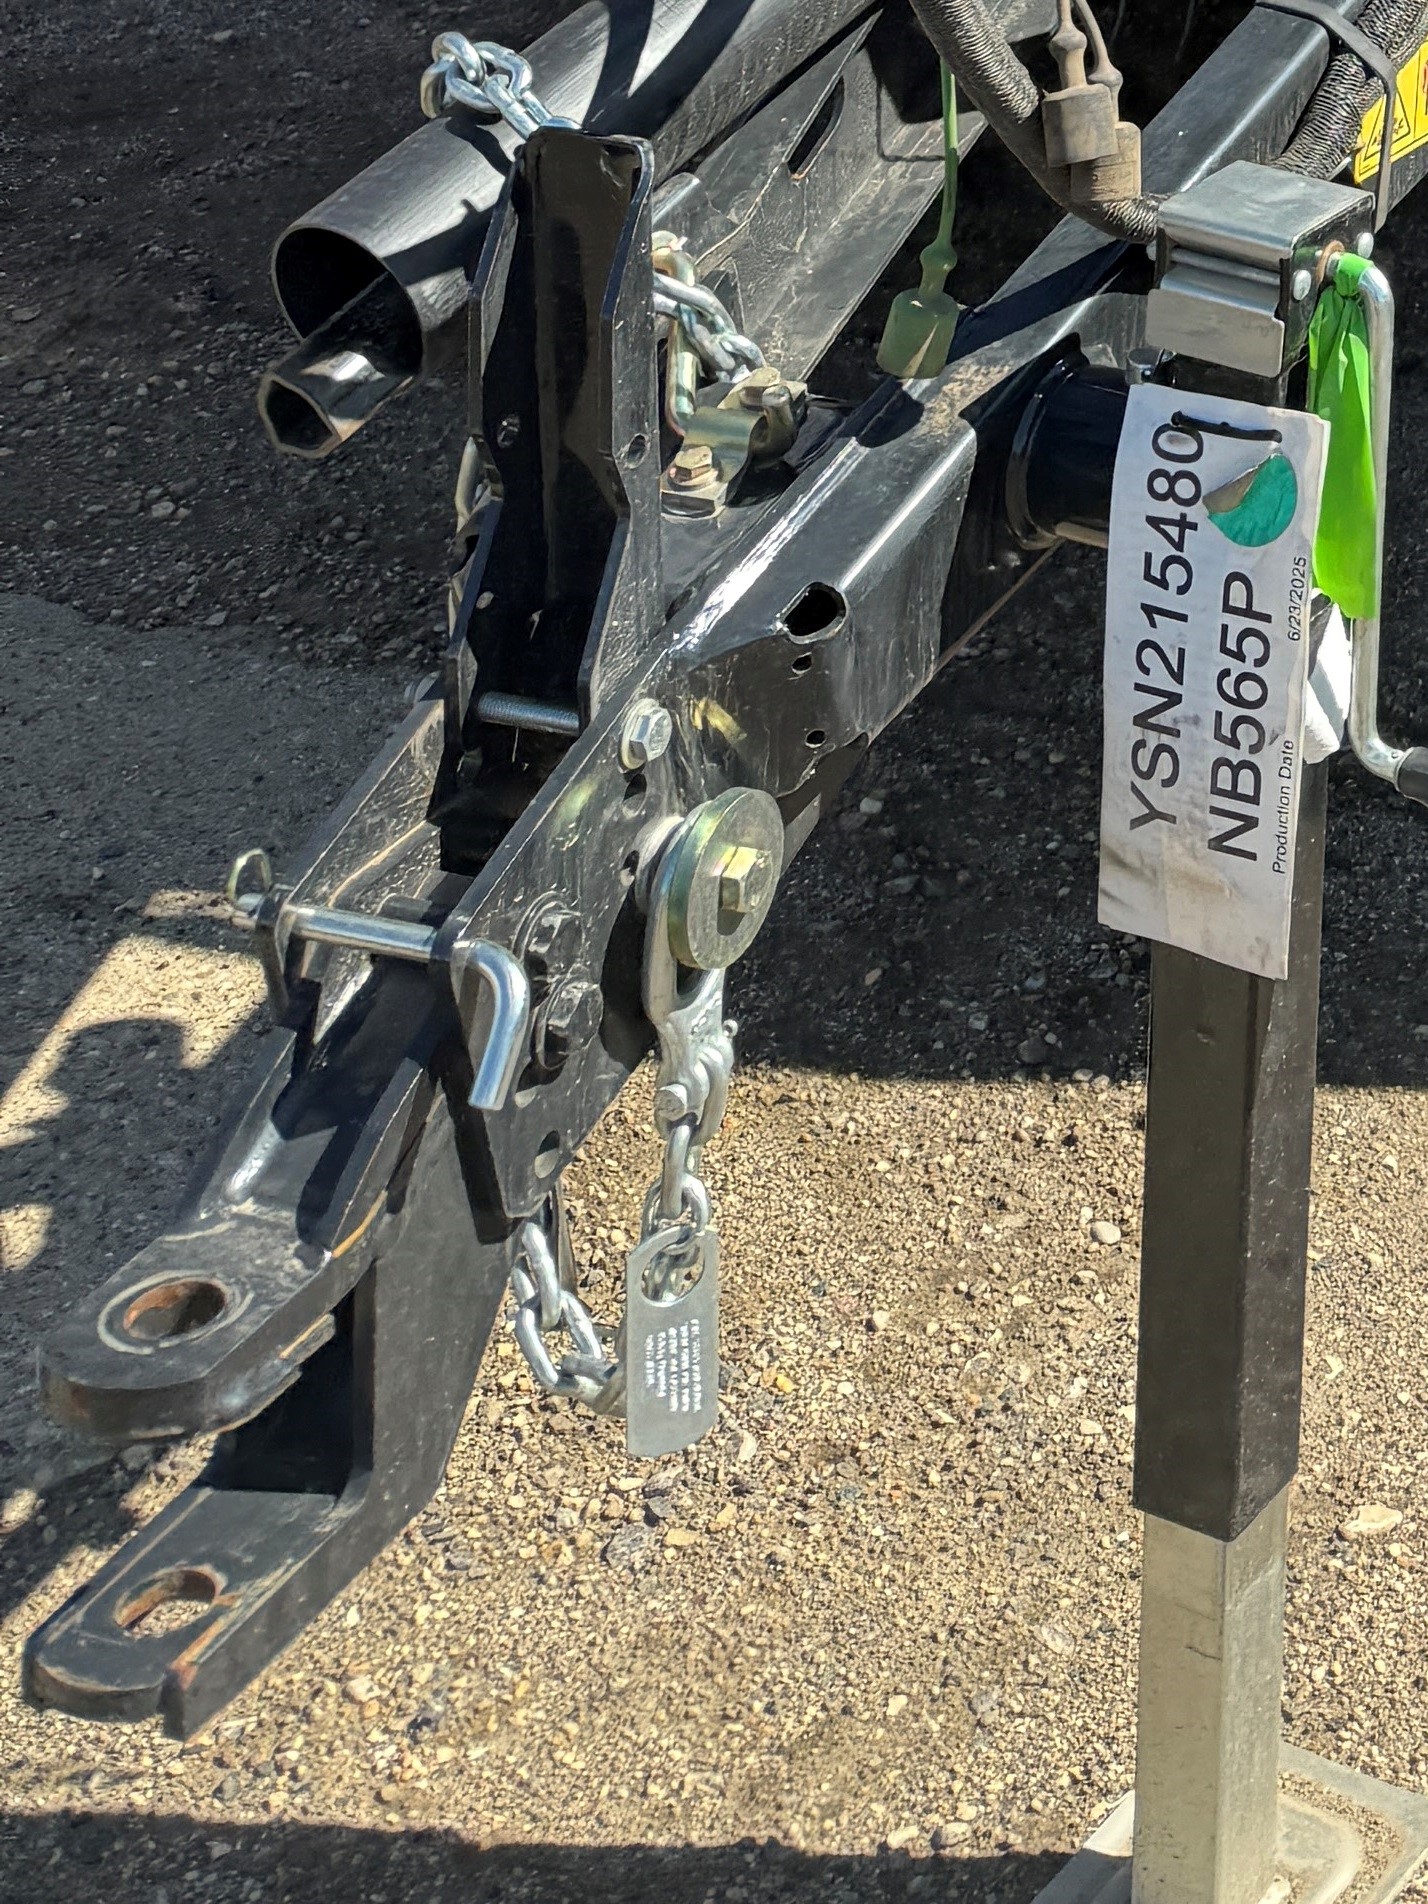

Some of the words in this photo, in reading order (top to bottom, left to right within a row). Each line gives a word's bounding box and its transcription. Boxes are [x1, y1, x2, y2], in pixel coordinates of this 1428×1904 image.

[1129, 422, 1205, 830] YSN215480
[1207, 570, 1273, 862] NB565P
[1272, 783, 1292, 874] Production
[1279, 739, 1294, 780] Date
